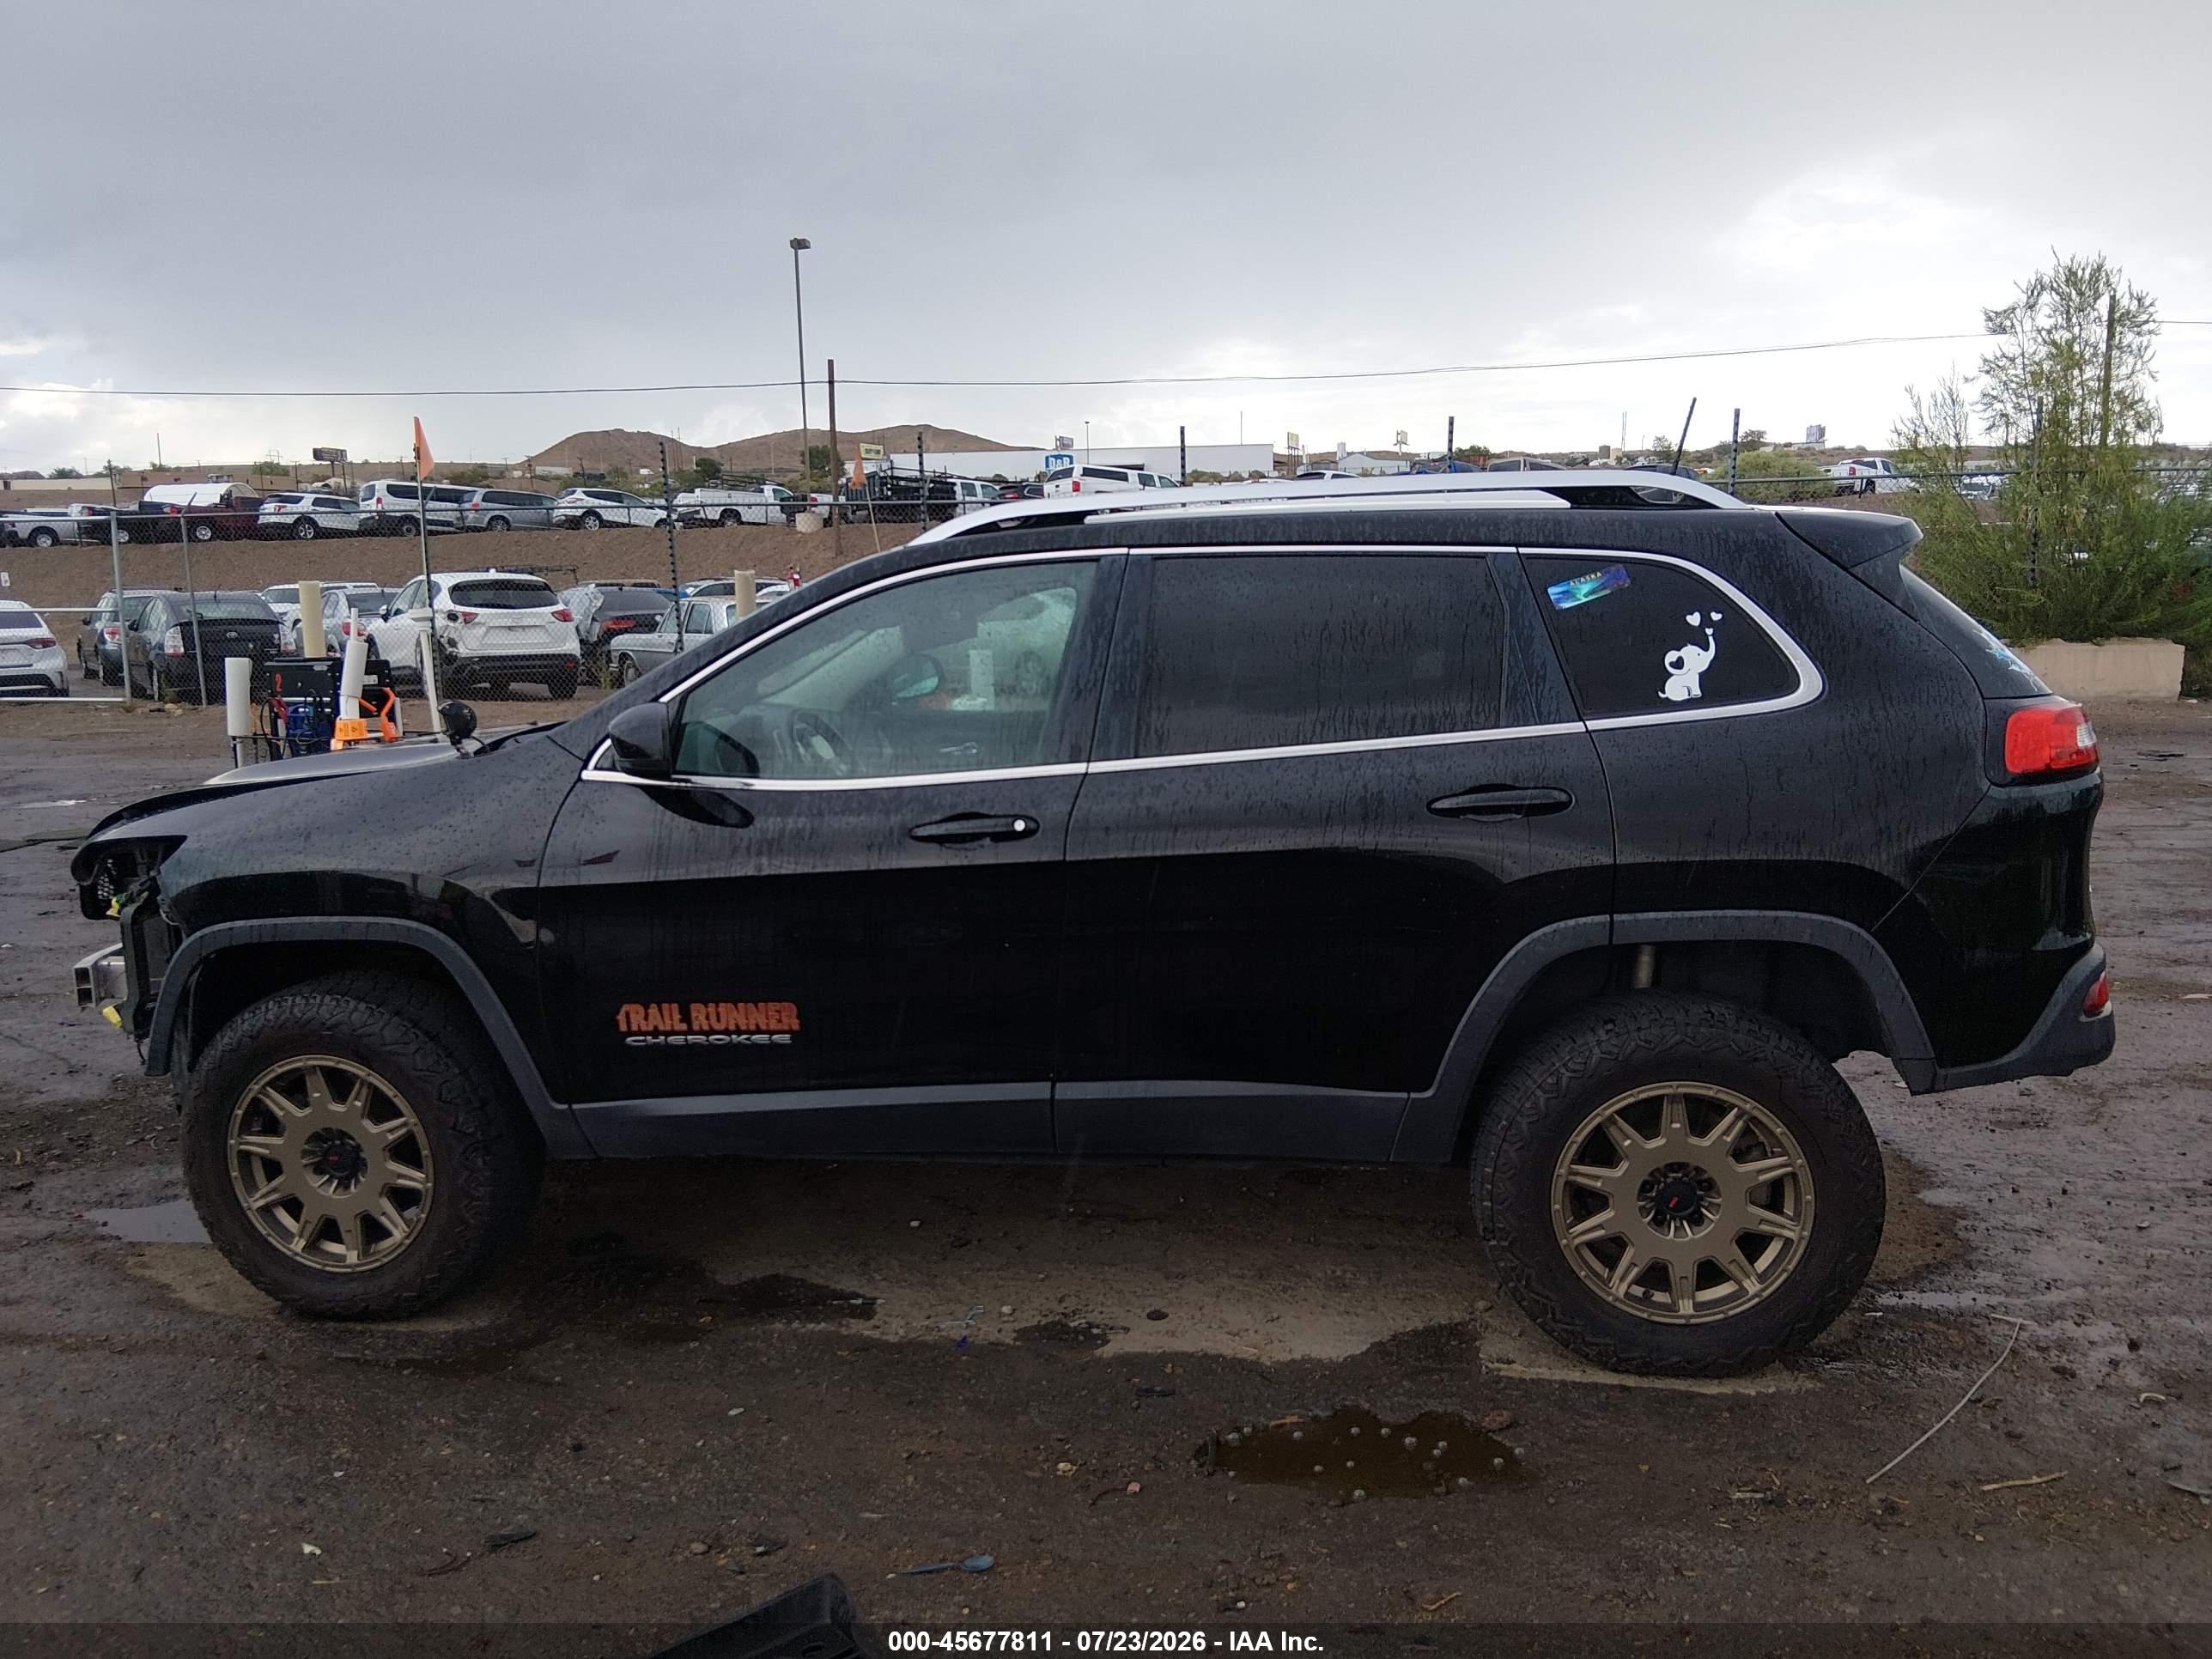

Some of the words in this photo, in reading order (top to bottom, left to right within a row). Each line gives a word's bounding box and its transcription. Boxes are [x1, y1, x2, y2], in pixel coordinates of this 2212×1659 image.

[1570, 571, 1602, 586] ALASKA
[616, 1002, 688, 1032] TRAIL
[690, 1001, 801, 1031] RUNNER
[624, 1034, 793, 1047] CHEROKEE
